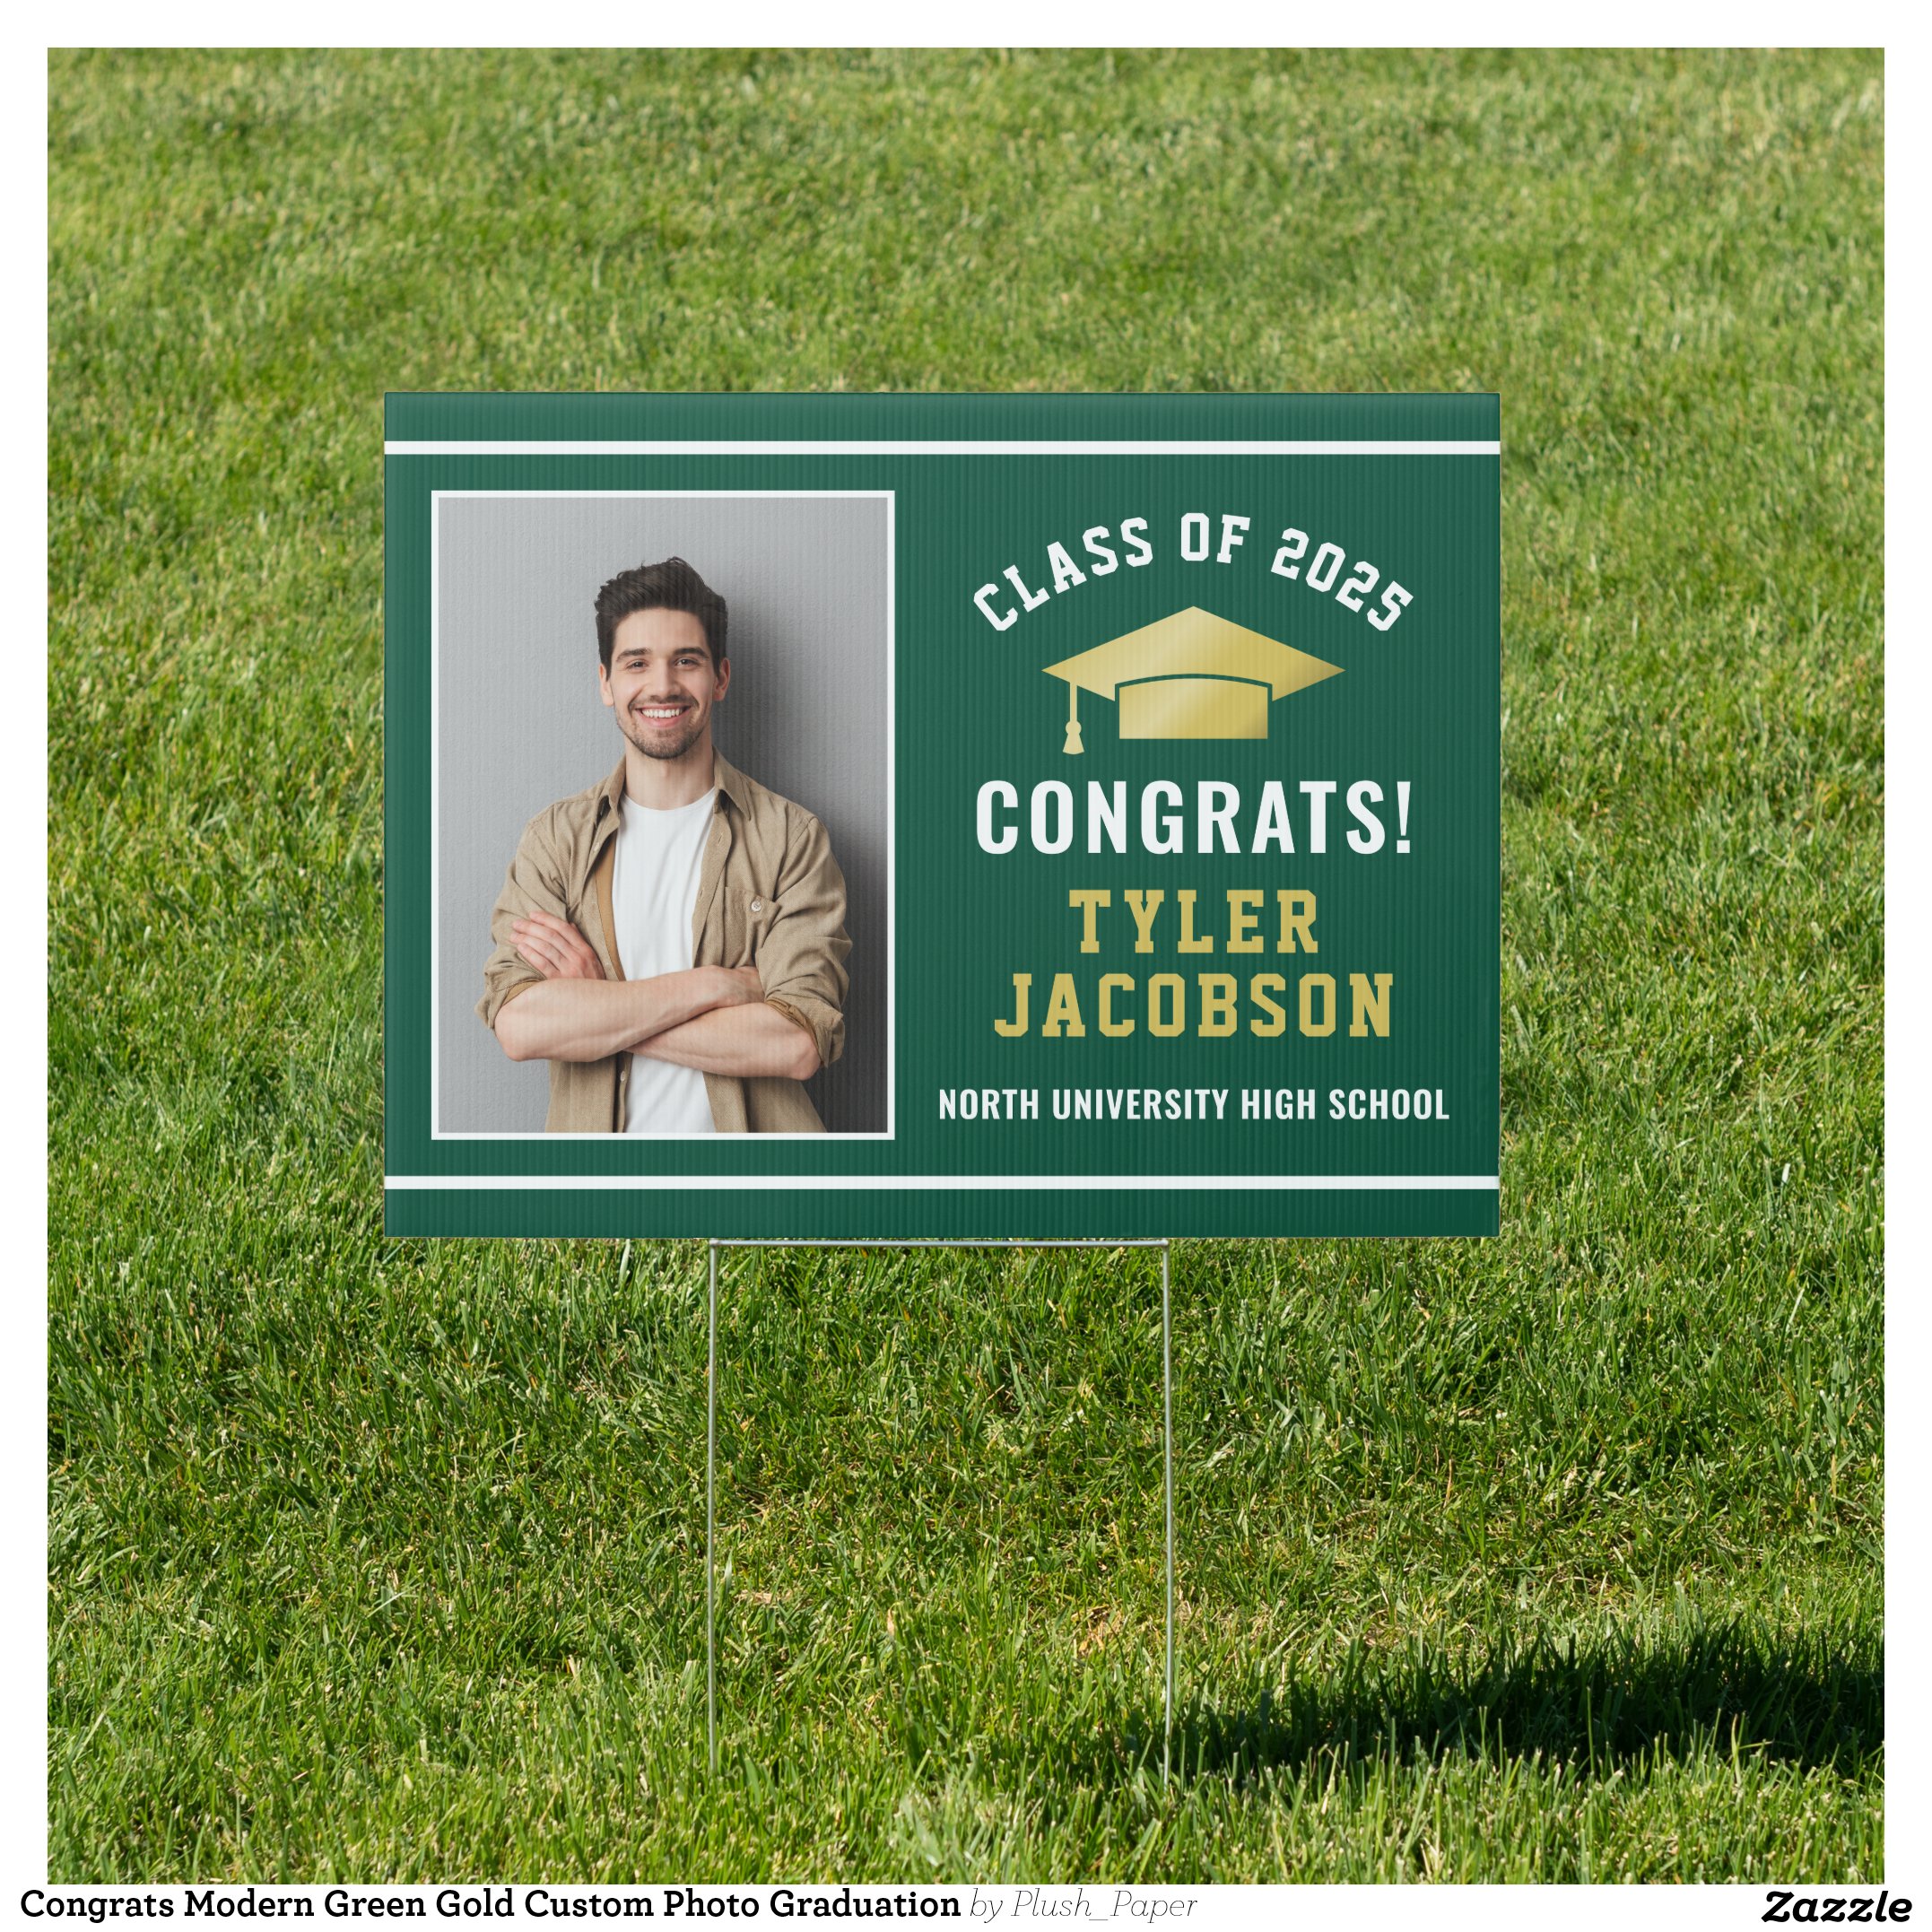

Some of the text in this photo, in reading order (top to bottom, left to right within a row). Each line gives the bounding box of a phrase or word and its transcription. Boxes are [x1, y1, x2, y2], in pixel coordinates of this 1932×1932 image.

[974, 513, 1413, 631] CLASS OF 2025
[977, 780, 1410, 854] CONGRATS!
[1070, 890, 1318, 953] TYLER
[995, 974, 1392, 1036] JACOBSON
[940, 1089, 1449, 1119] NORTH UNIVERSITY HIGH SCHOOL
